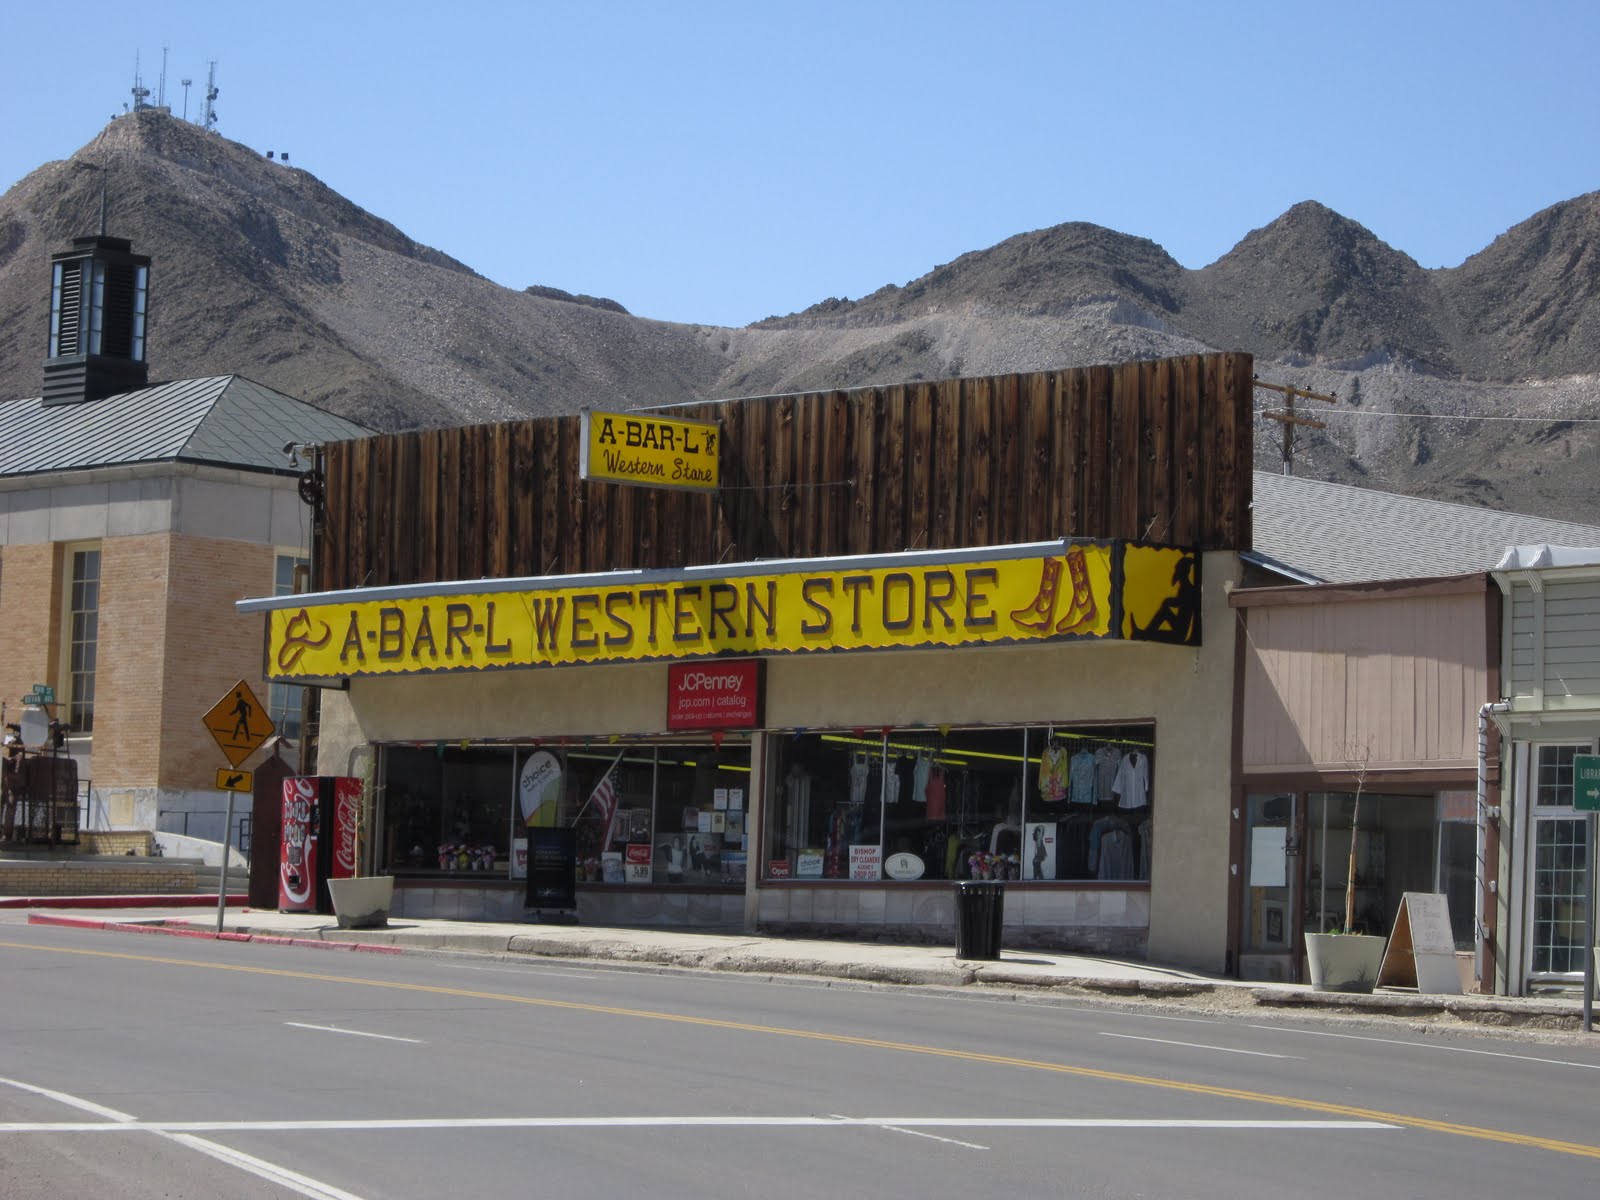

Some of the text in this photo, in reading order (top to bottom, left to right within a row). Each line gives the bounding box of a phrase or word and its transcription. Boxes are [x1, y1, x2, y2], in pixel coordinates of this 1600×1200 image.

[599, 418, 699, 454] A-BAR-L
[603, 449, 713, 482] Western Store
[339, 568, 998, 661] A-BAR-L WESTERN STORE
[678, 672, 743, 692] JCPenney
[678, 694, 747, 710] jcp.com catalog
[522, 760, 552, 788] choice
[771, 867, 789, 875] Open
[854, 870, 877, 879] DROP OFF
